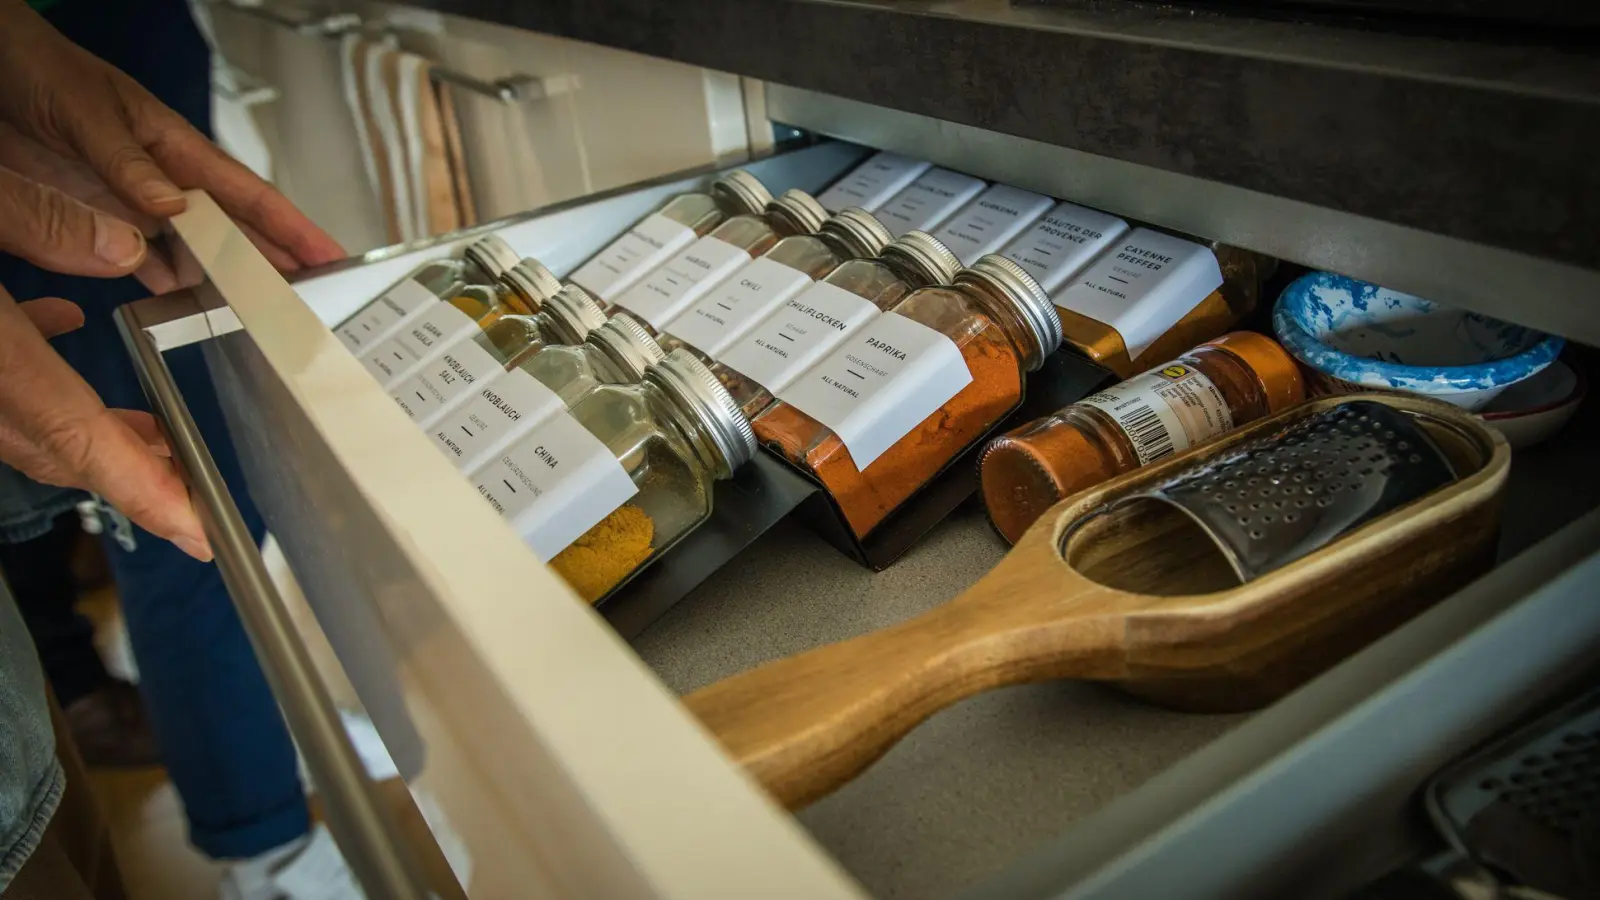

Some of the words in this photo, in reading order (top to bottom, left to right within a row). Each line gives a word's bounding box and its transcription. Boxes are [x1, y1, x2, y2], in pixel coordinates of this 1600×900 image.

[1039, 225, 1086, 244] PROVENCE
[1081, 228, 1102, 240] DER
[1117, 252, 1163, 272] PFEFFER
[1124, 244, 1173, 264] CAYENNE
[740, 279, 763, 291] CHILI
[1084, 281, 1096, 289] ALL
[1097, 285, 1127, 300] NATURAL
[786, 299, 847, 331] CHILIFLOCKEN
[755, 338, 764, 347] ALL
[765, 343, 789, 359] NATURAL
[865, 337, 907, 361] PAPRIKA
[438, 369, 456, 385] SALZ
[444, 354, 475, 385] KNOBLAUCH
[844, 353, 889, 378] ROSENSCHARF
[821, 375, 831, 385] ALL
[832, 380, 860, 399] NATURAL
[481, 388, 522, 422] KNOBLAUCH
[1120, 420, 1140, 442] 2000
[437, 432, 447, 442] ALL
[446, 439, 463, 457] NATURAL
[534, 445, 559, 469] CHINA
[477, 484, 486, 496] ALL
[485, 492, 505, 515] NATURAL
